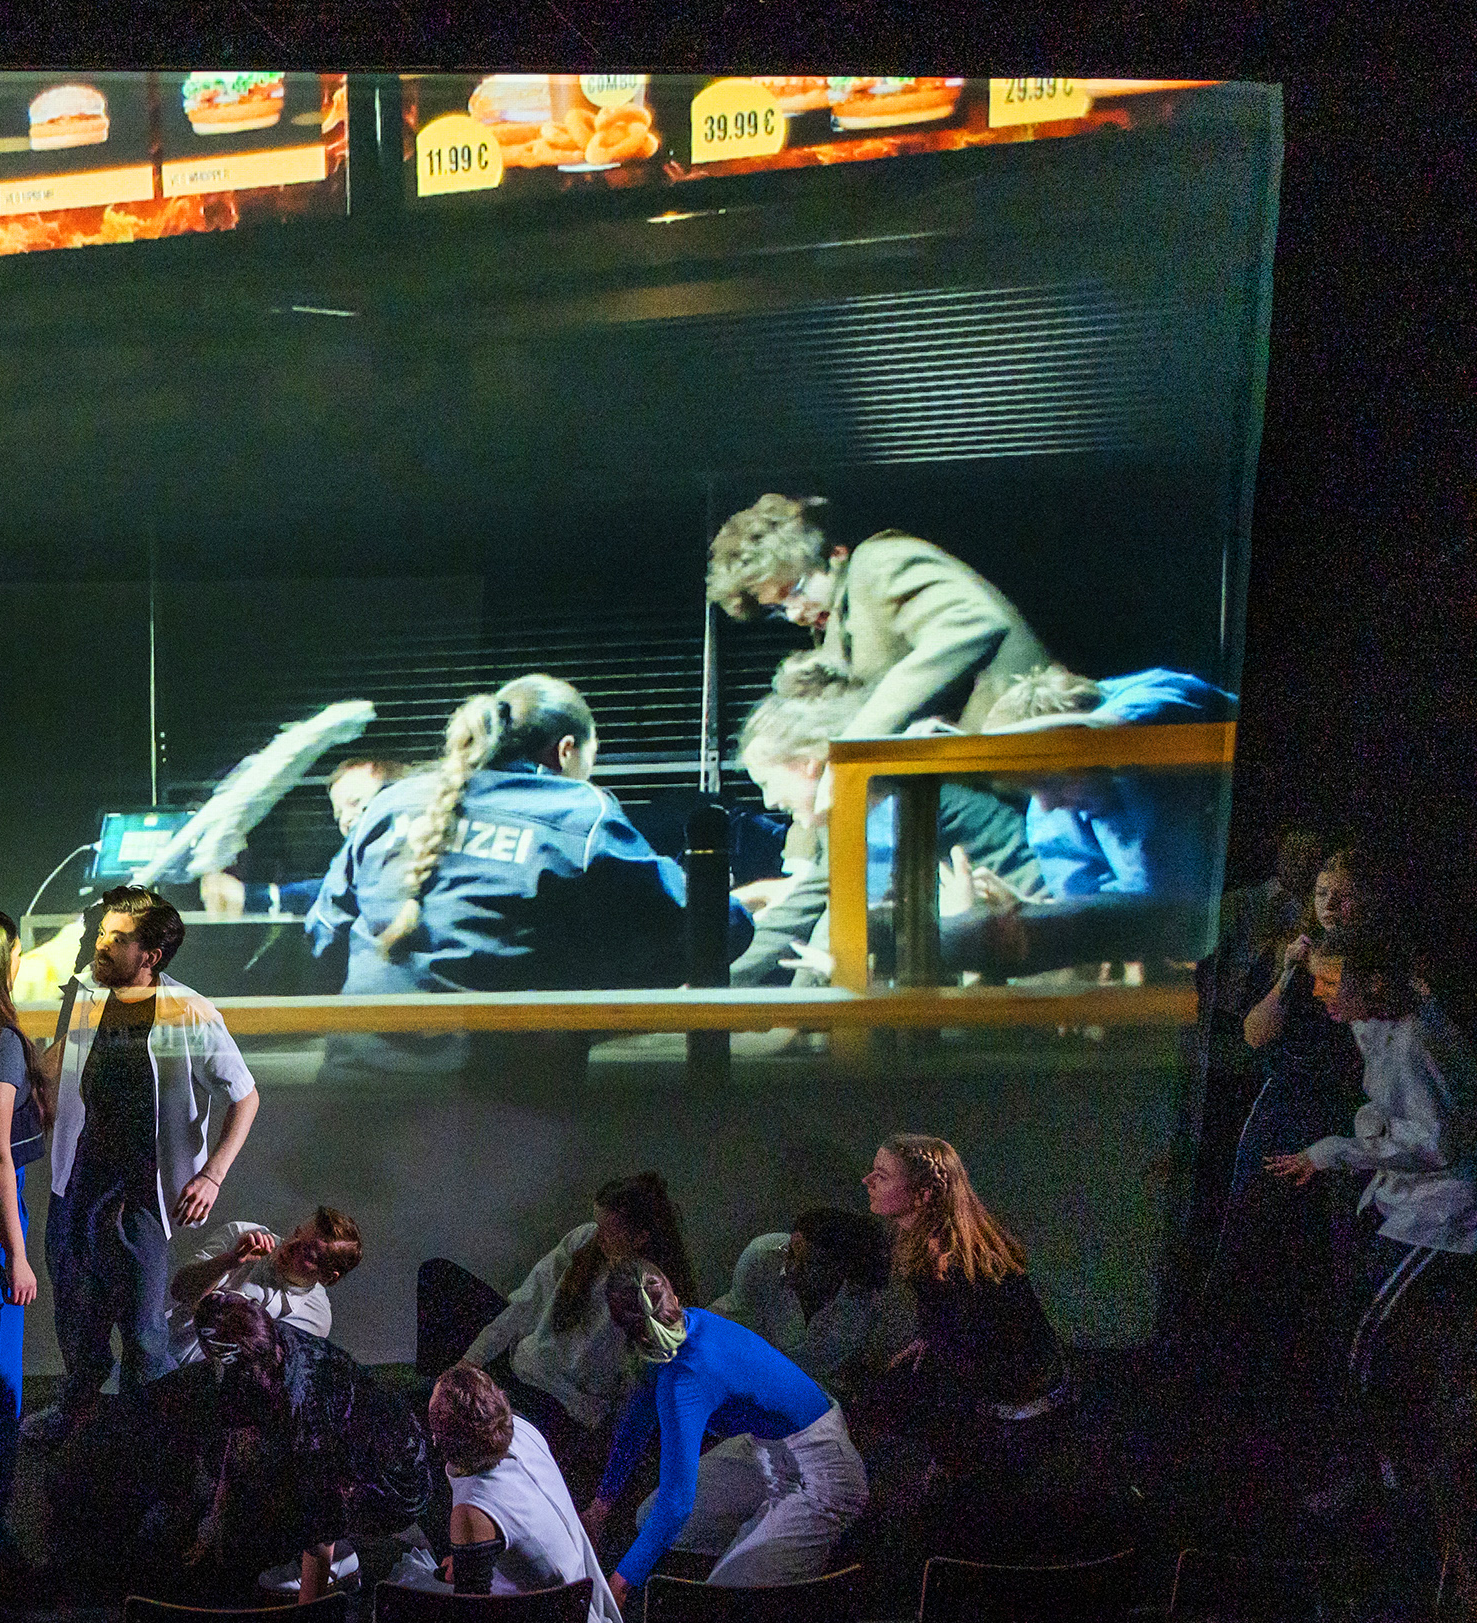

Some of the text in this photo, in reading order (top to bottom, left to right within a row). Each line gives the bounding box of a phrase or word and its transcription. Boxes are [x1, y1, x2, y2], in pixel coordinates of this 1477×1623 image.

[704, 108, 775, 143] 39.99 €
[426, 144, 472, 177] 11.99
